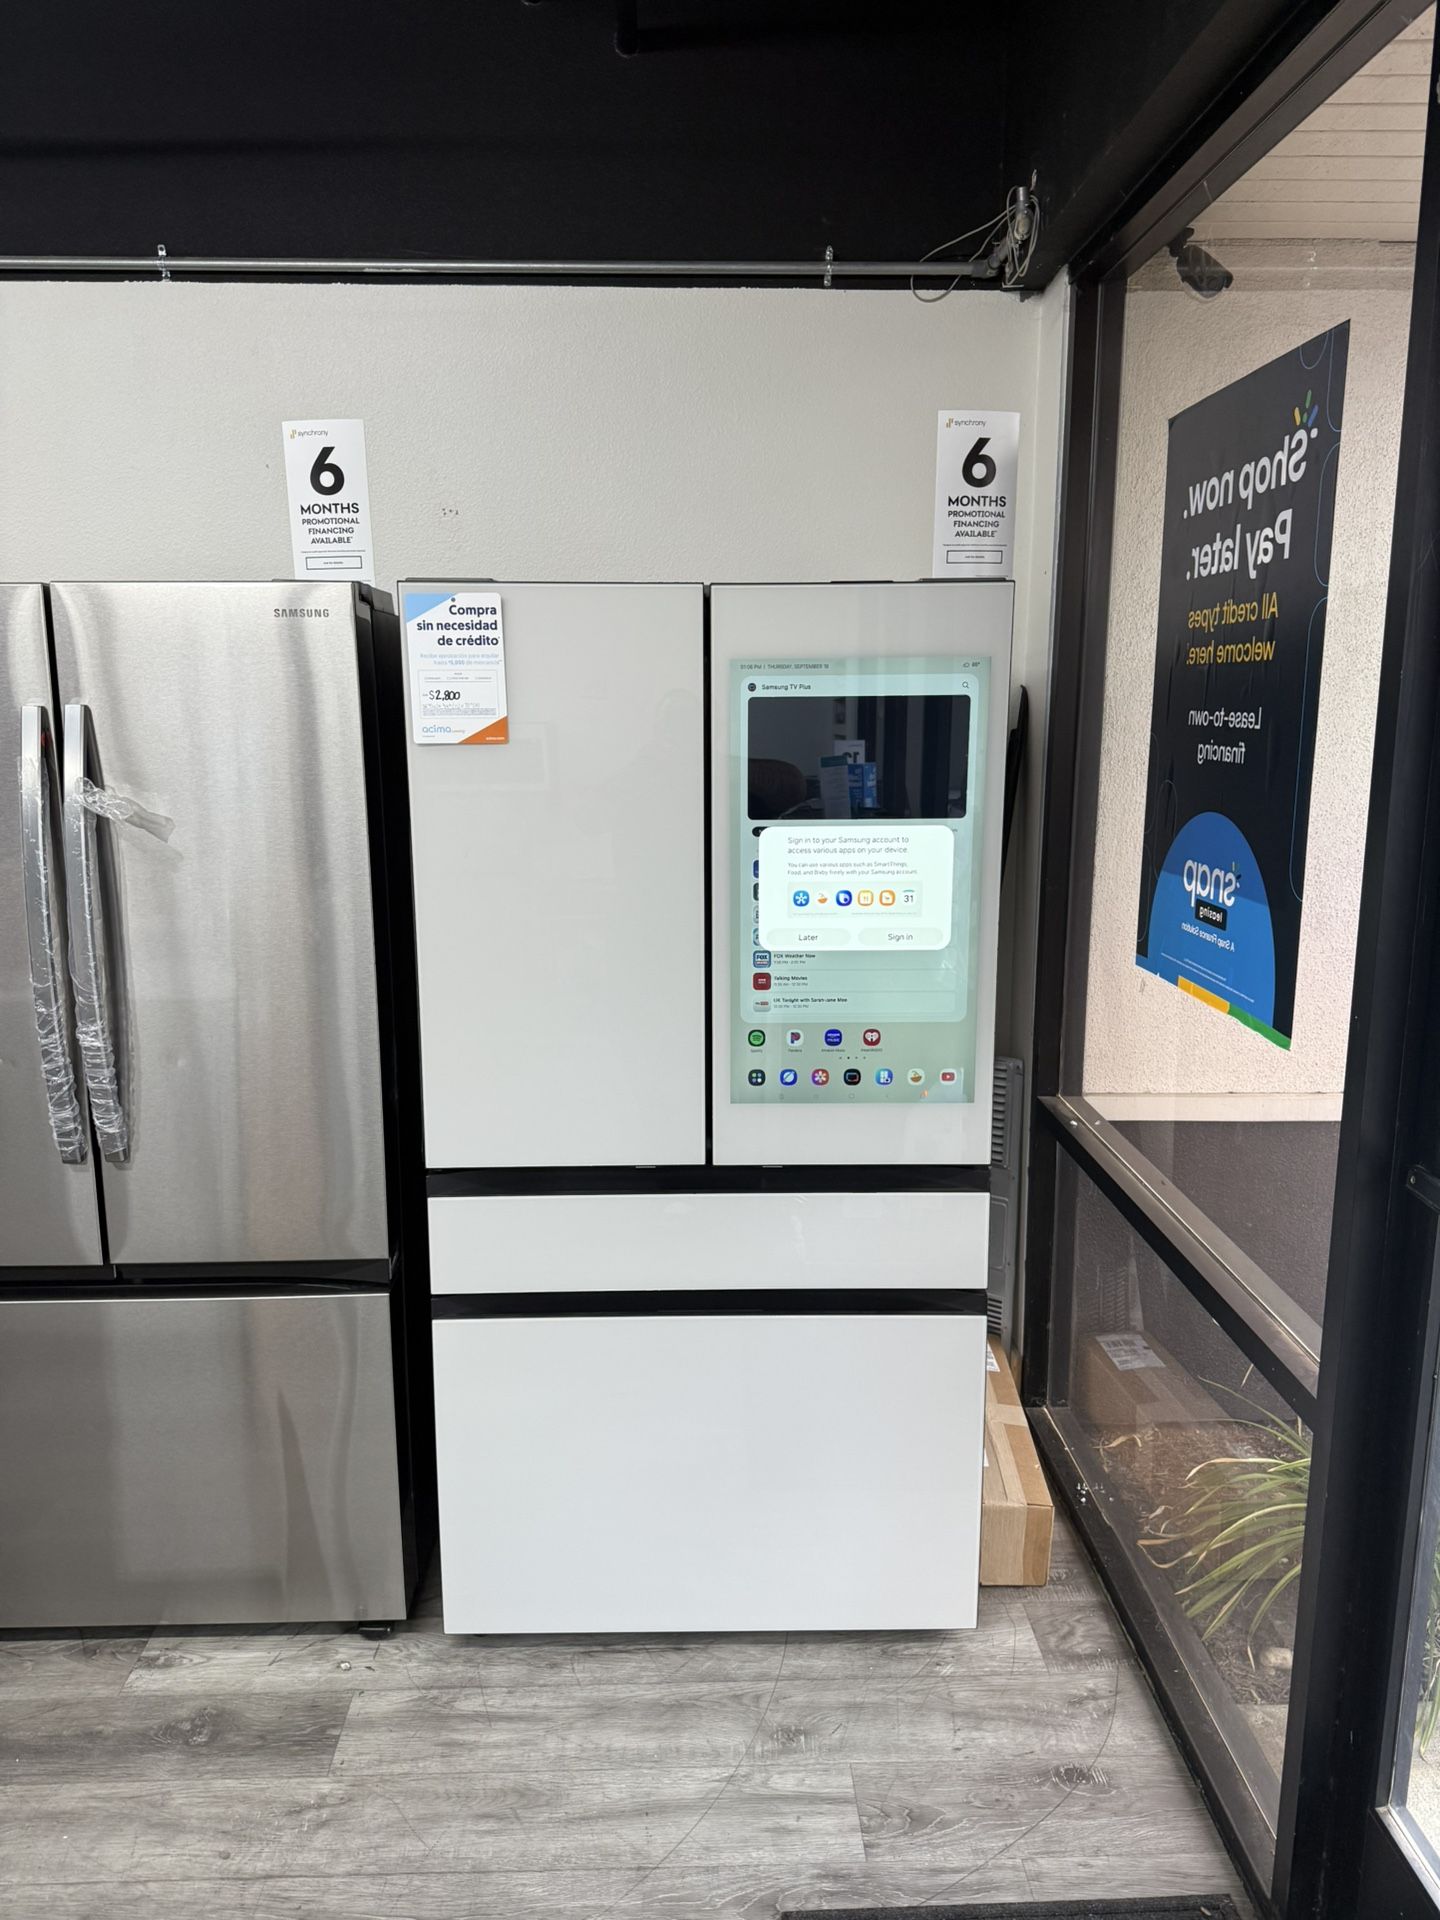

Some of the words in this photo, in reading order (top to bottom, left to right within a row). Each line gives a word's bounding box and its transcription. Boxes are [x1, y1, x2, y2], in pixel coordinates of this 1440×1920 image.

[954, 418, 987, 428] synchrony
[297, 429, 328, 438] synchrony
[962, 437, 997, 488] 6
[310, 446, 345, 496] 6
[948, 495, 1006, 507] MONTHS
[300, 502, 360, 515] MONTHS
[948, 510, 1005, 519] PROMOTIONAL
[302, 517, 360, 526] PROMOTIONAL
[953, 520, 1000, 528] FINANCING
[308, 526, 354, 535] FINANCING
[273, 608, 329, 618] SAMSUNG
[449, 604, 497, 617] Compra
[416, 620, 434, 631] sin
[436, 619, 498, 631] necesidad
[437, 635, 453, 646] de
[422, 725, 451, 733] acima
[788, 837, 803, 845] Sign
[838, 837, 871, 845] Samsung
[904, 895, 914, 903] 31
[888, 933, 904, 942] Sign
